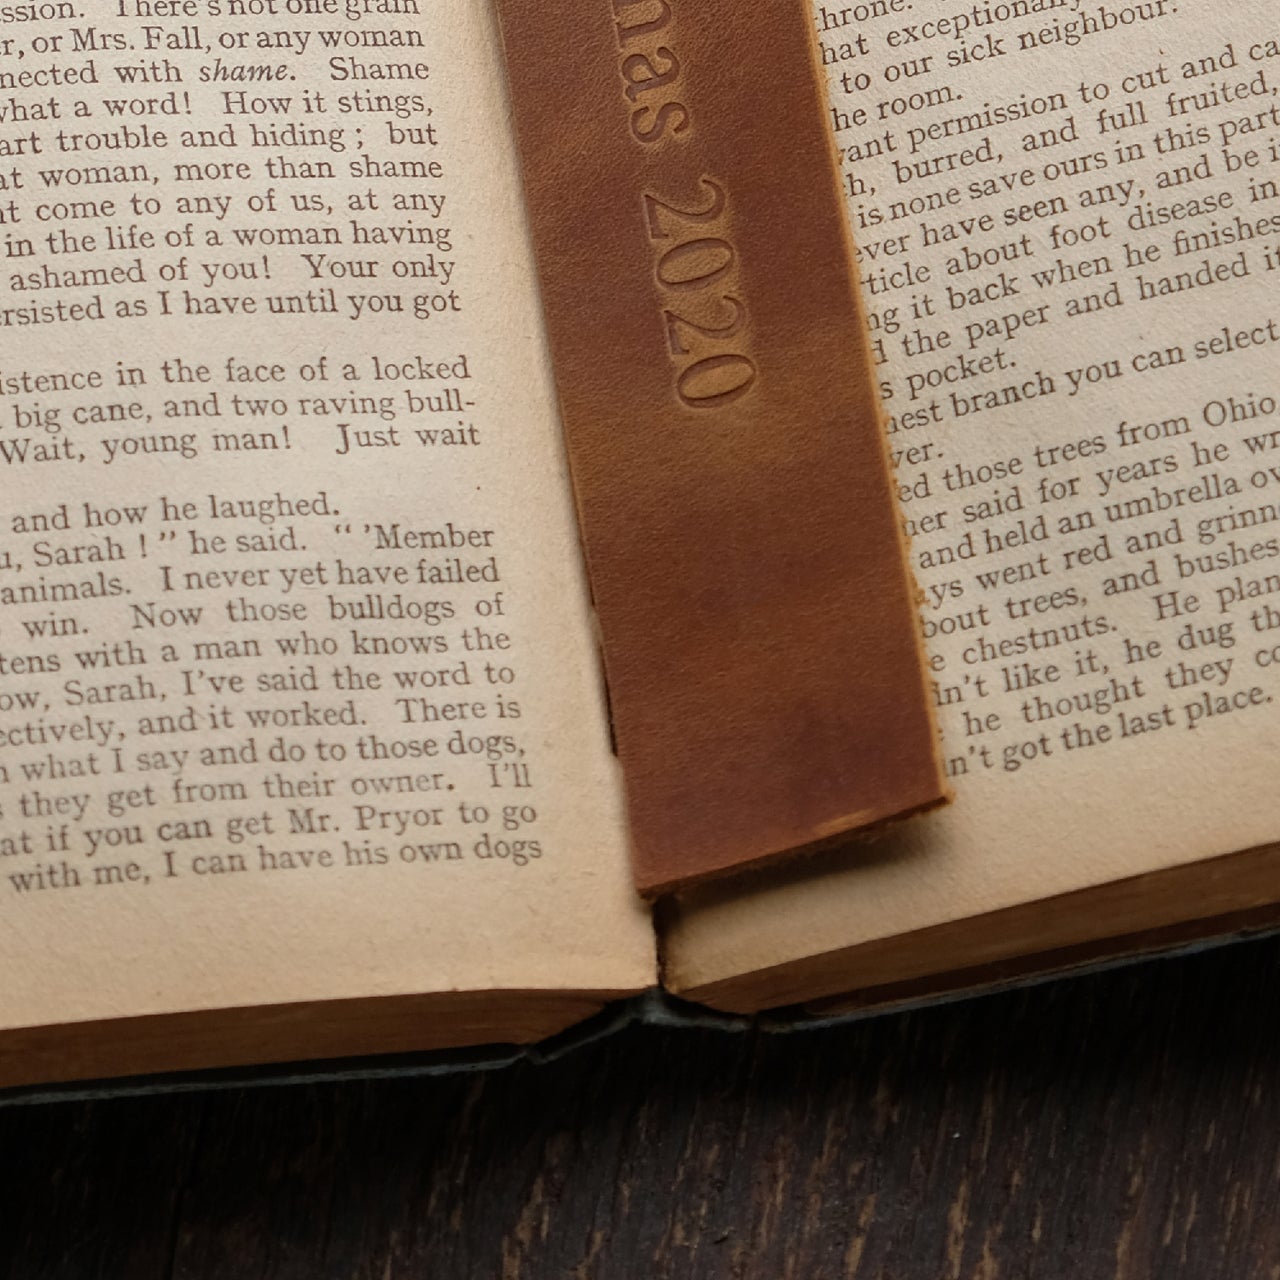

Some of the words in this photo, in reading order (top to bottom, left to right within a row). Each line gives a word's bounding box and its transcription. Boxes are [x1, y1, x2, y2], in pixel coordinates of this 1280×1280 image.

[905, 92, 1070, 156] permission
[1076, 80, 1111, 105] to
[1120, 62, 1172, 95] cut
[1179, 42, 1240, 81] and
[34, 199, 117, 223] come
[128, 192, 163, 217] to
[174, 194, 234, 222] any
[246, 186, 278, 214] of
[288, 193, 334, 217] us,
[346, 187, 380, 212] at
[391, 192, 448, 220] any
[918, 213, 996, 249] have
[1002, 195, 1070, 228] seen
[1077, 178, 1146, 209] any,
[1154, 152, 1215, 191] and
[1220, 147, 1261, 174] be
[644, 176, 758, 410] 2020
[11, 403, 63, 435] big
[71, 401, 153, 426] cane,
[162, 390, 223, 419] and
[230, 393, 289, 418] two
[297, 396, 397, 422] raving
[403, 387, 477, 415] bull-
[940, 456, 1024, 493] those
[1032, 434, 1108, 469] trees
[1115, 415, 1193, 449] from
[11, 503, 72, 535] and
[82, 501, 149, 529] how
[159, 495, 199, 523] he
[207, 490, 341, 526] laughed.
[974, 552, 1052, 591] went
[1061, 533, 1114, 572] red
[1125, 516, 1185, 555] and
[1002, 733, 1054, 773] got
[1059, 721, 1113, 752] the
[1116, 703, 1176, 740] last
[1182, 685, 1273, 731] place.
[46, 823, 70, 852] if
[82, 824, 145, 859] you
[156, 818, 214, 843] can
[226, 812, 275, 844] get
[286, 806, 341, 835] Mr.
[353, 804, 444, 837] Pryor
[457, 803, 490, 825] to
[501, 805, 538, 832] go
